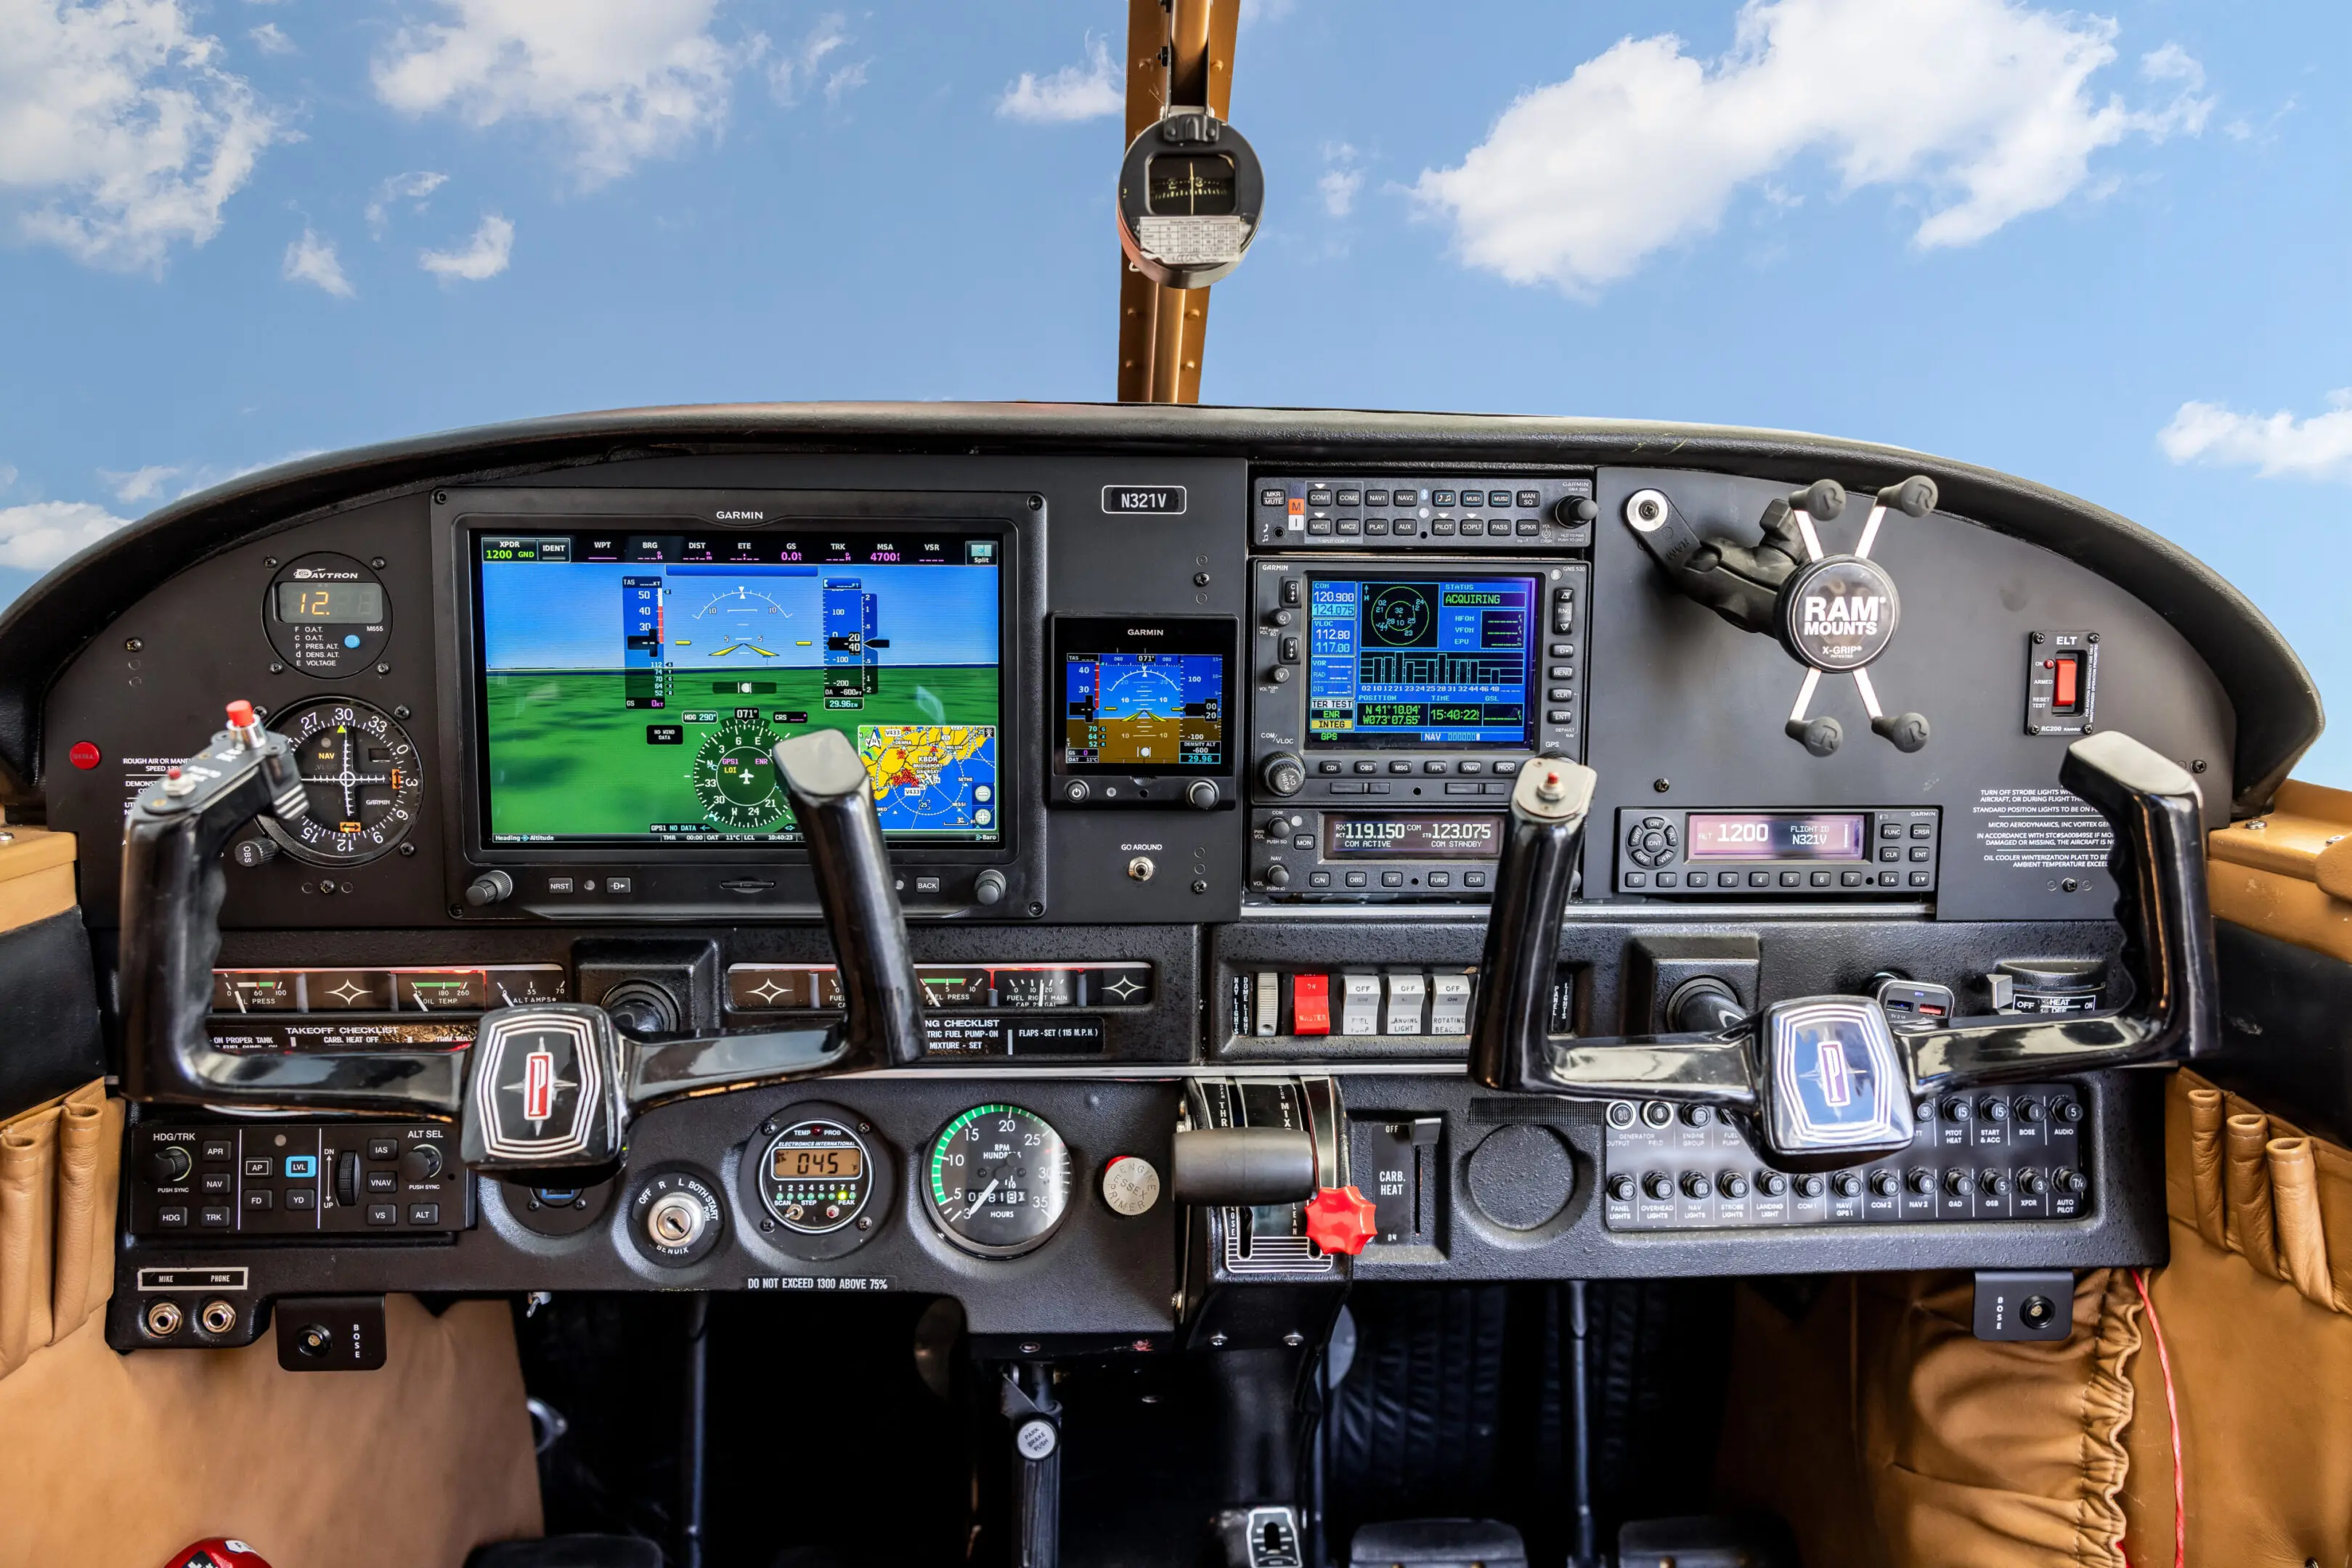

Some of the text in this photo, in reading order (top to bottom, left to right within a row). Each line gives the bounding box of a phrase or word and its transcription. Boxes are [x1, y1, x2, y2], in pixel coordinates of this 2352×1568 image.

[1121, 494, 1167, 508] N321V
[716, 511, 763, 520] GARMIN
[486, 550, 513, 559] 1200
[1314, 591, 1354, 603] 120.900
[1445, 594, 1500, 605] ACQUIRING
[1313, 604, 1354, 616] 124.075
[1804, 621, 1877, 635] MOUNTS
[1316, 629, 1351, 640] 112.80
[1316, 642, 1351, 653] 117.00
[335, 708, 353, 721] 30
[1319, 720, 1346, 729] INTEG
[1346, 823, 1405, 839] 119.150
[1431, 823, 1491, 839] 123.075
[1717, 823, 1769, 843] 1200
[1792, 834, 1826, 845] N321V
[998, 1119, 1014, 1132] 20
[1385, 1124, 1399, 1133] OFF
[1380, 1170, 1406, 1183] CARB.
[1380, 1183, 1403, 1196] HEAT
[748, 1278, 887, 1289] DO NOT EXCEED 1300 ABOVE 75%
[1025, 1428, 1038, 1440] PARK
[1028, 1432, 1046, 1447] BRAKE
[1033, 1439, 1049, 1452] PUSH
